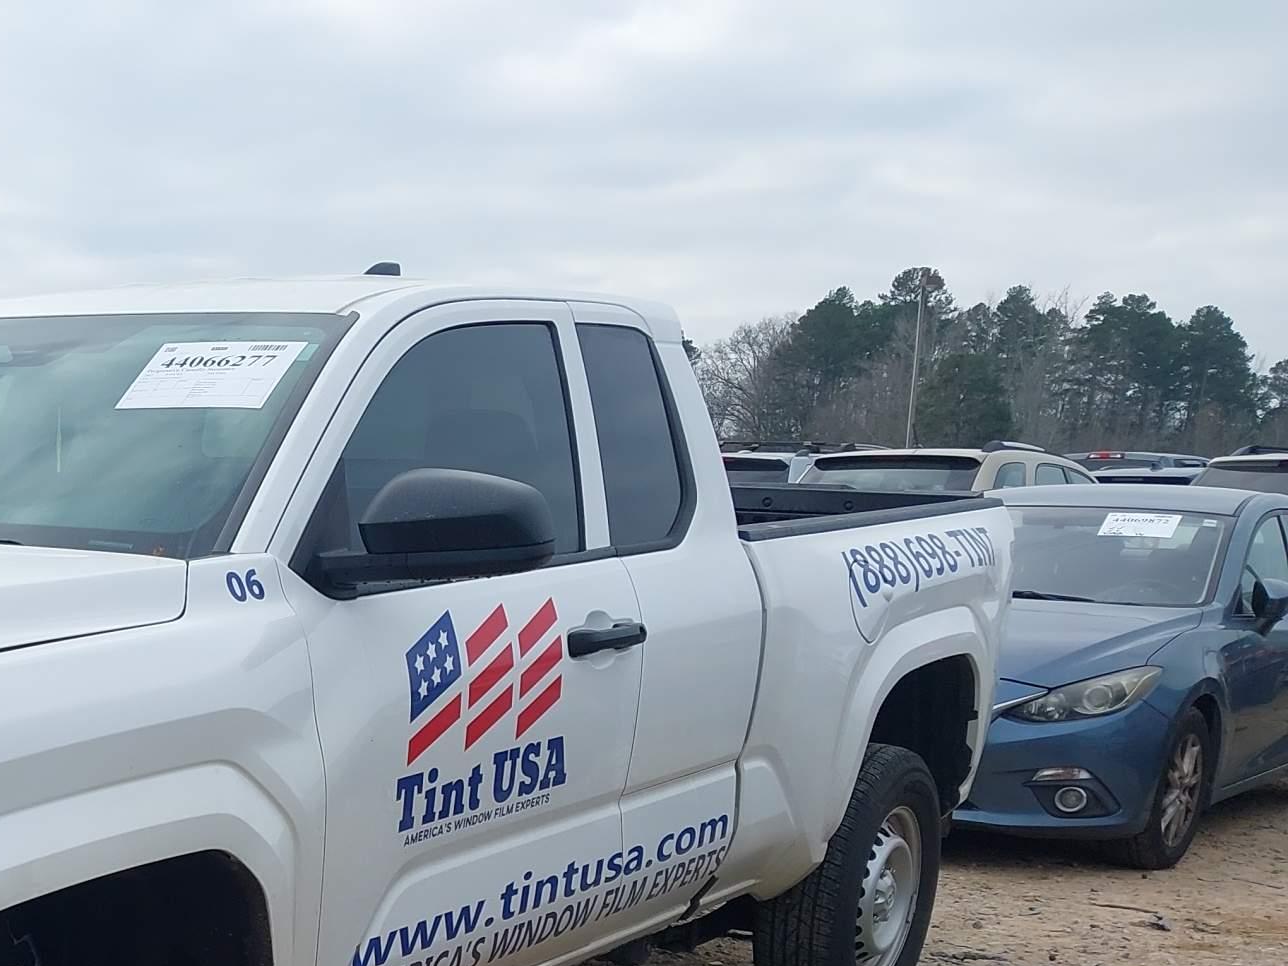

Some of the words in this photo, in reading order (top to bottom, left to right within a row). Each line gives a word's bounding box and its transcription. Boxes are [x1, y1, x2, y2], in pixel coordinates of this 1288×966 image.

[161, 355, 278, 369] 44066277
[226, 568, 265, 602] 06
[841, 527, 996, 608] (888)698-TINT
[396, 764, 484, 833] Tint
[493, 735, 567, 803] USA
[404, 822, 452, 847] AMERICA'S
[454, 810, 494, 831] WINDOW
[493, 806, 513, 819] FILM
[515, 793, 551, 813] EXPERTS
[487, 895, 598, 964] WINDOW
[595, 876, 648, 922] FILM
[646, 845, 727, 901] EXPERTS
